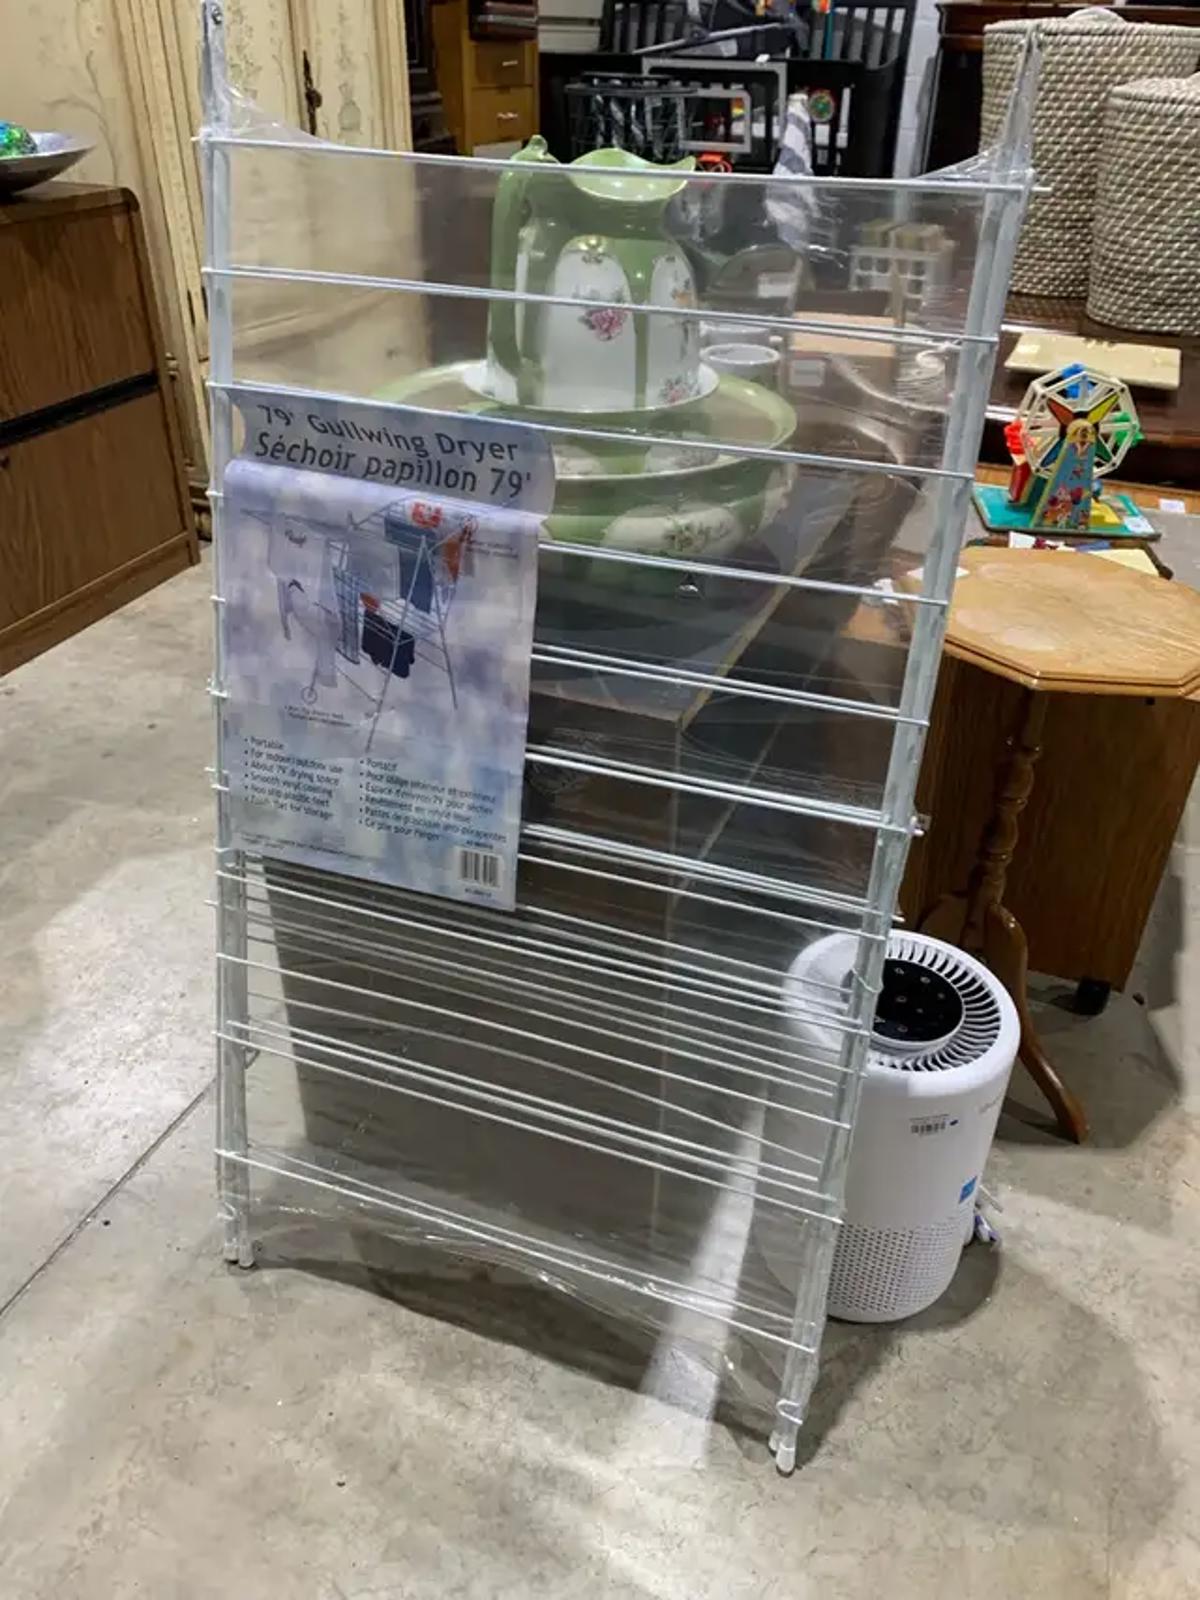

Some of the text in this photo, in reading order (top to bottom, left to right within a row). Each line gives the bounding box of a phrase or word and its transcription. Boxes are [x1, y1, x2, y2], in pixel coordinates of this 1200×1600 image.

[255, 431, 531, 498] Séchoir papillon 79'
[257, 405, 518, 464] 79' Gullwing Dryer
